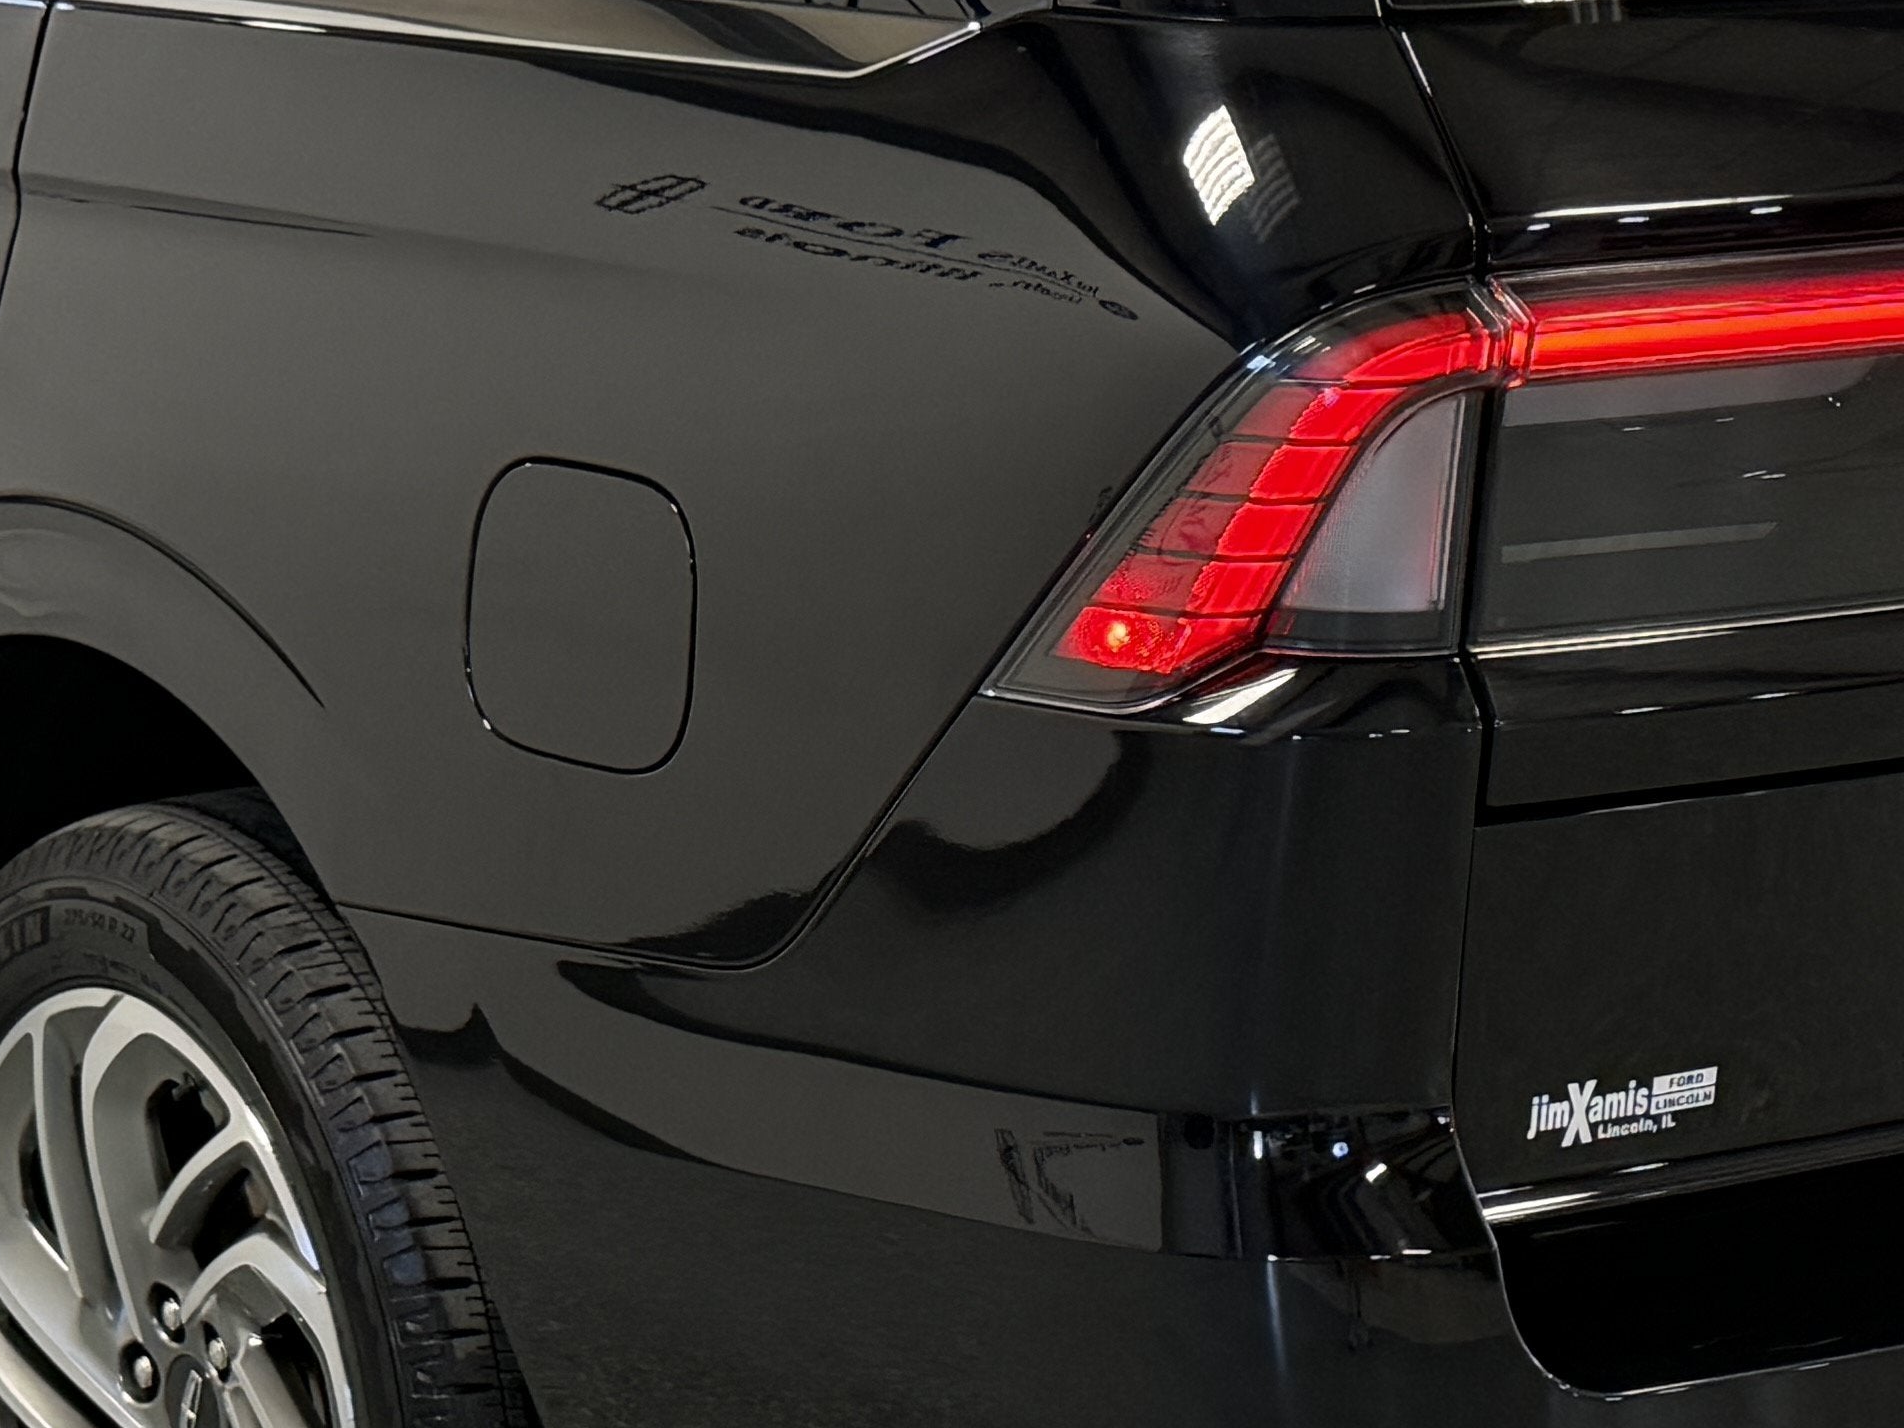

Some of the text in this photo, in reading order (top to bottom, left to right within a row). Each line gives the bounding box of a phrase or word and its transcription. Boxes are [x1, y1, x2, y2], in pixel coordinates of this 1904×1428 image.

[1668, 1072, 1705, 1089] FORD
[1654, 1089, 1713, 1111] LINCOLN
[1525, 1078, 1650, 1148] jimXamis
[1660, 1113, 1677, 1130] IL
